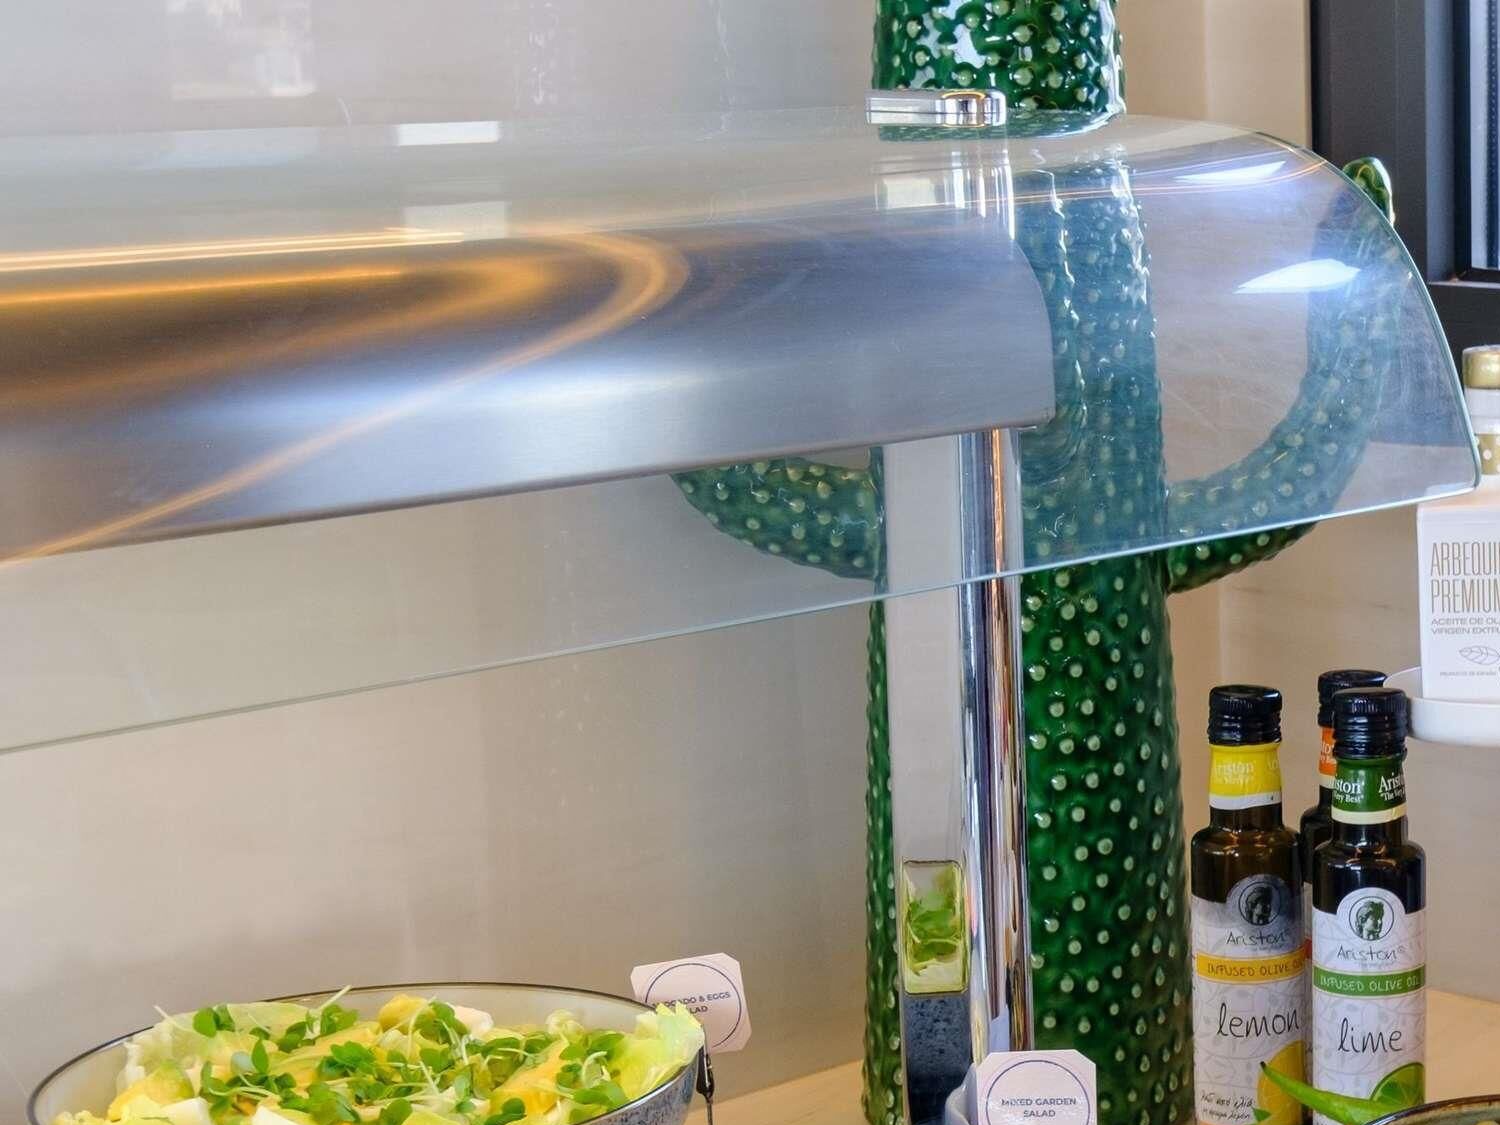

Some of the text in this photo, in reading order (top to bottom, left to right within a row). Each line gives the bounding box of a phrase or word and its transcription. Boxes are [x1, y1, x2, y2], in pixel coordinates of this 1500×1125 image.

[1431, 617, 1467, 626] ACEITE
[1468, 617, 1483, 626] DE
[1431, 626, 1470, 635] VIRGEN
[1207, 962, 1256, 977] INFUSED
[1259, 964, 1290, 977] OLIVE
[1319, 975, 1420, 992] INFUSED OLIVE OIL
[698, 995, 706, 1003] &
[706, 991, 731, 1002] EGGS
[1216, 1002, 1301, 1039] lemon
[1337, 1017, 1403, 1054] lime
[1001, 1097, 1077, 1107] MIXED GARDEN
[1022, 1108, 1056, 1118] SALAD
